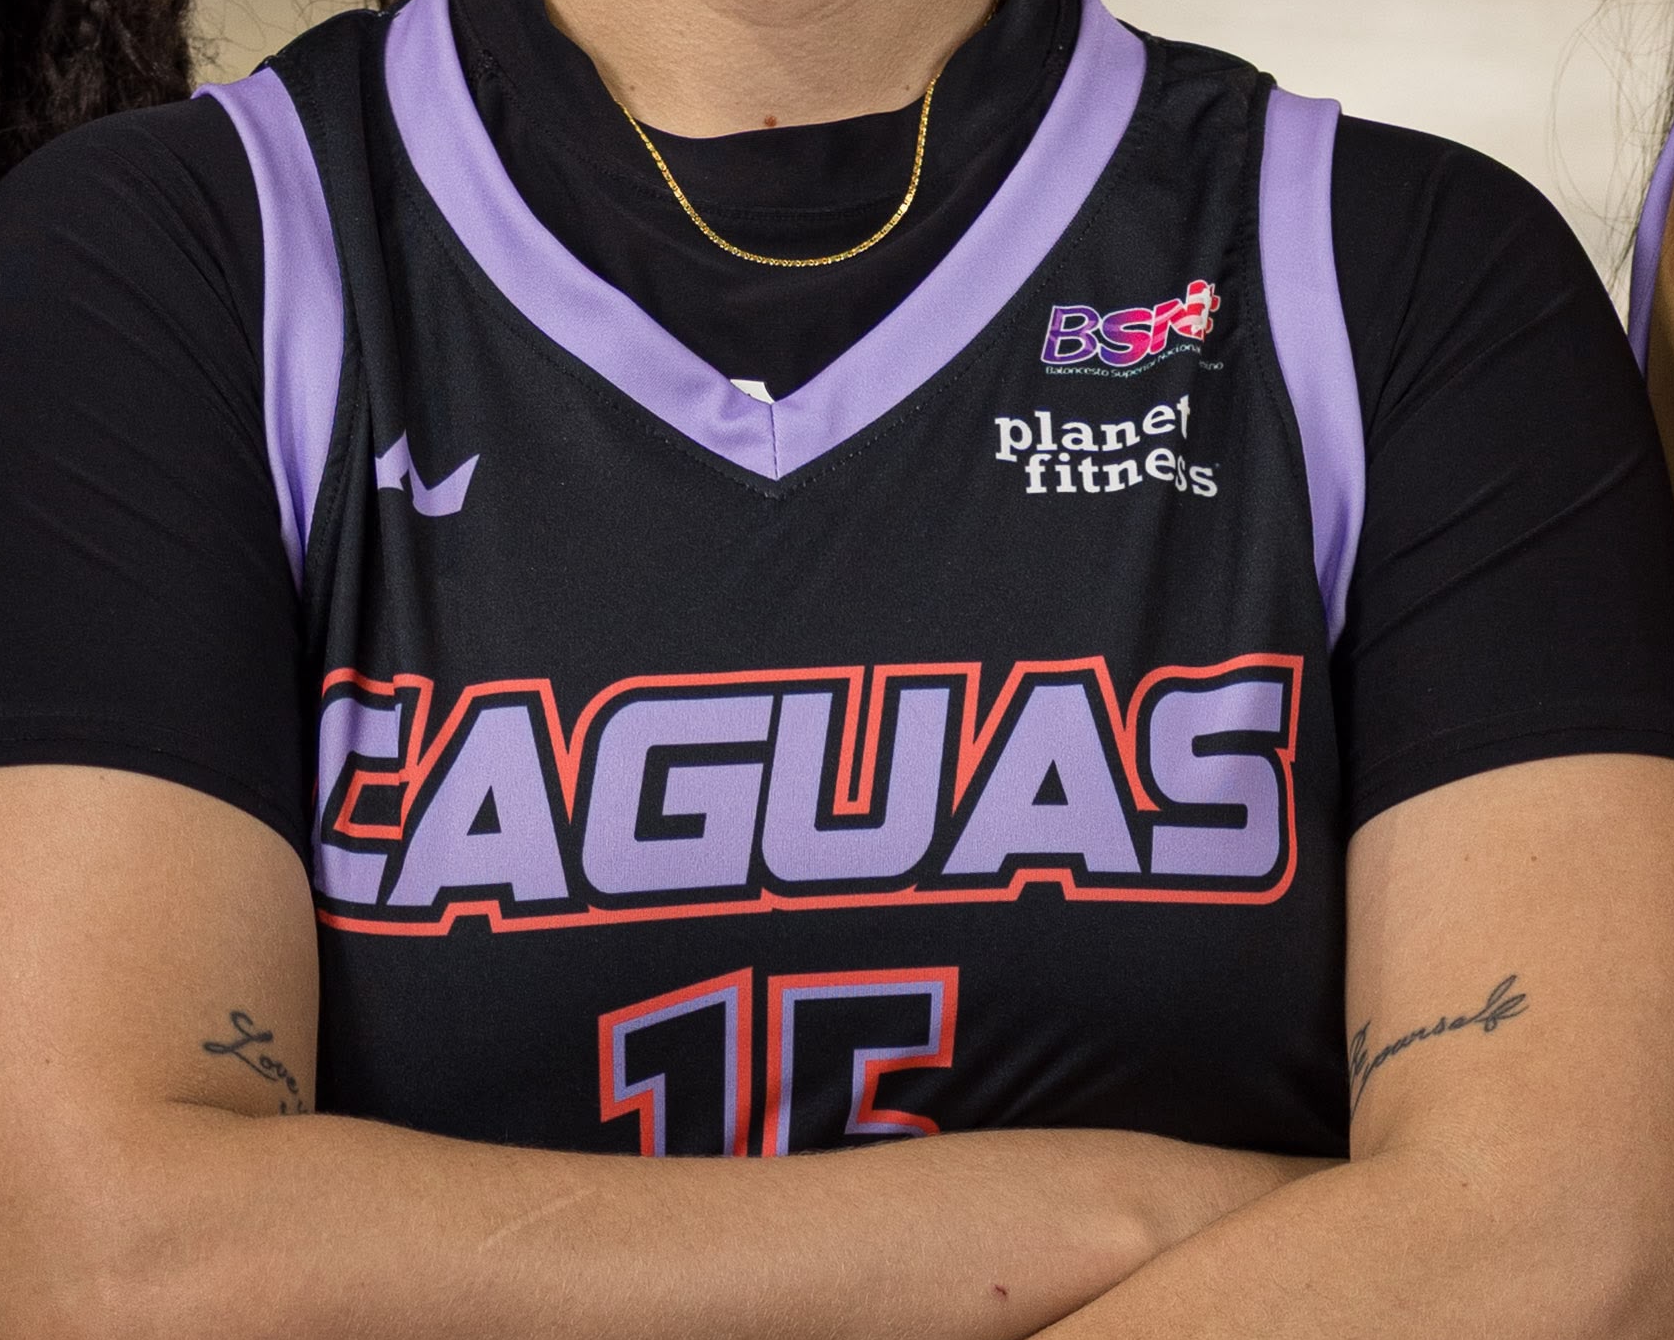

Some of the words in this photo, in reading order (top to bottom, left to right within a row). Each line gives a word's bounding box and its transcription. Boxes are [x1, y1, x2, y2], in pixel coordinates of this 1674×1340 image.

[1040, 279, 1221, 367] BSN
[994, 394, 1191, 462] planet
[1025, 446, 1219, 498] fitness
[312, 653, 1303, 936] CAGUAS
